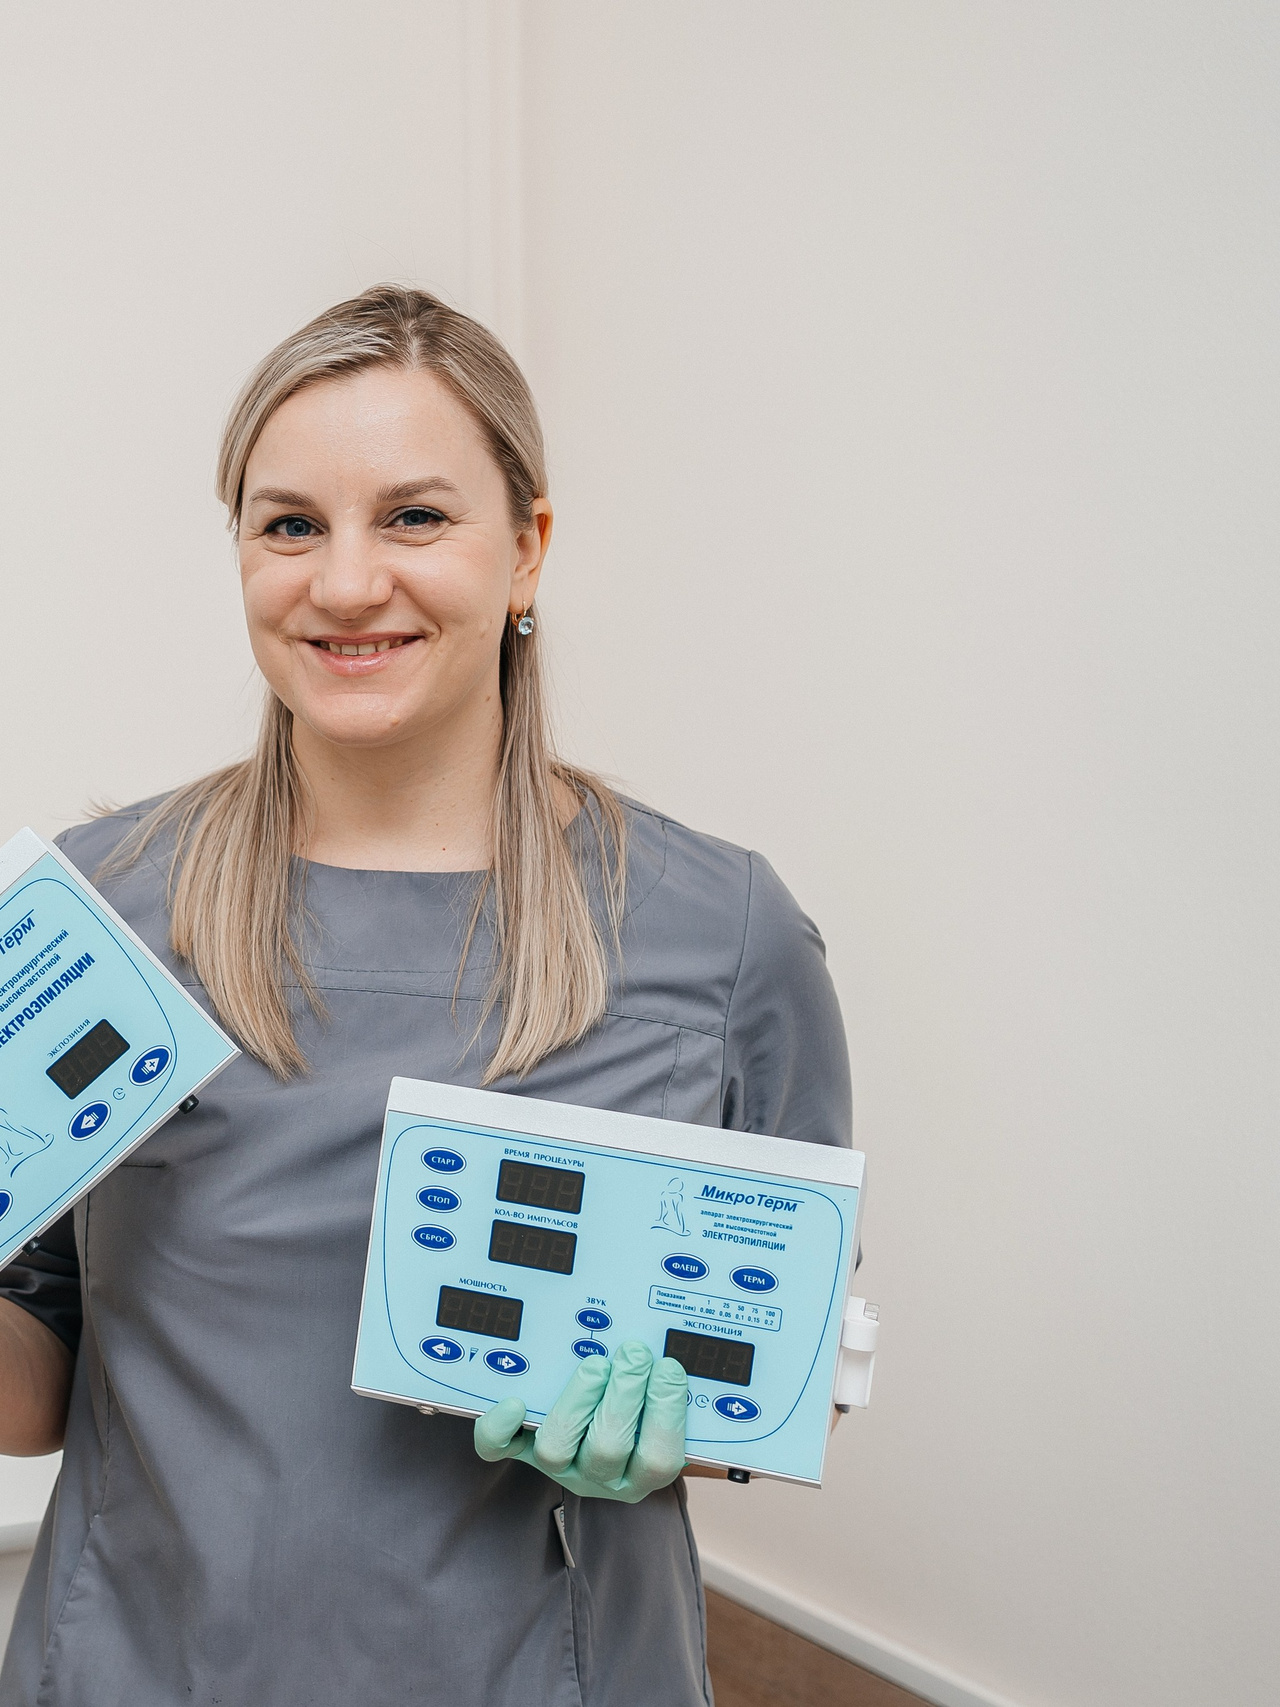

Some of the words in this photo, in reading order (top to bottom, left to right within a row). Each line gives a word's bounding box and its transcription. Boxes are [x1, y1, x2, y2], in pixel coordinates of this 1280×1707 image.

[47, 1019, 91, 1059] ЭКСПОЗИЦИЯ
[431, 1156, 456, 1167] СТАРТ
[504, 1148, 530, 1159] ВРЕМЯ
[534, 1152, 585, 1168] ПРОЦЕДУРЫ
[427, 1194, 451, 1205] СТОП
[701, 1184, 798, 1212] МикроТерм
[494, 1208, 525, 1220] КОЛ-ВО
[527, 1213, 578, 1229] ИМПУЛЬСОВ
[700, 1210, 724, 1218] аппарат
[726, 1214, 793, 1230] электрохирургический
[726, 1224, 777, 1237] высокочастотной
[420, 1232, 448, 1244] СБРОС
[702, 1229, 786, 1251] ЭЛЕКТРОЭПИЛЯЦИИ
[672, 1262, 699, 1274] ФЛЕШ
[459, 1277, 508, 1293] МОЩНОСТЬ
[742, 1274, 766, 1286] ТЕРМ
[656, 1290, 686, 1300] Показания
[586, 1297, 606, 1306] ЗВУК
[656, 1299, 681, 1309] Значения
[586, 1316, 600, 1324] ВКЛ
[682, 1319, 743, 1337] ЭКСПОЗИЦИЯ
[579, 1345, 599, 1355] ВЫКЛ
